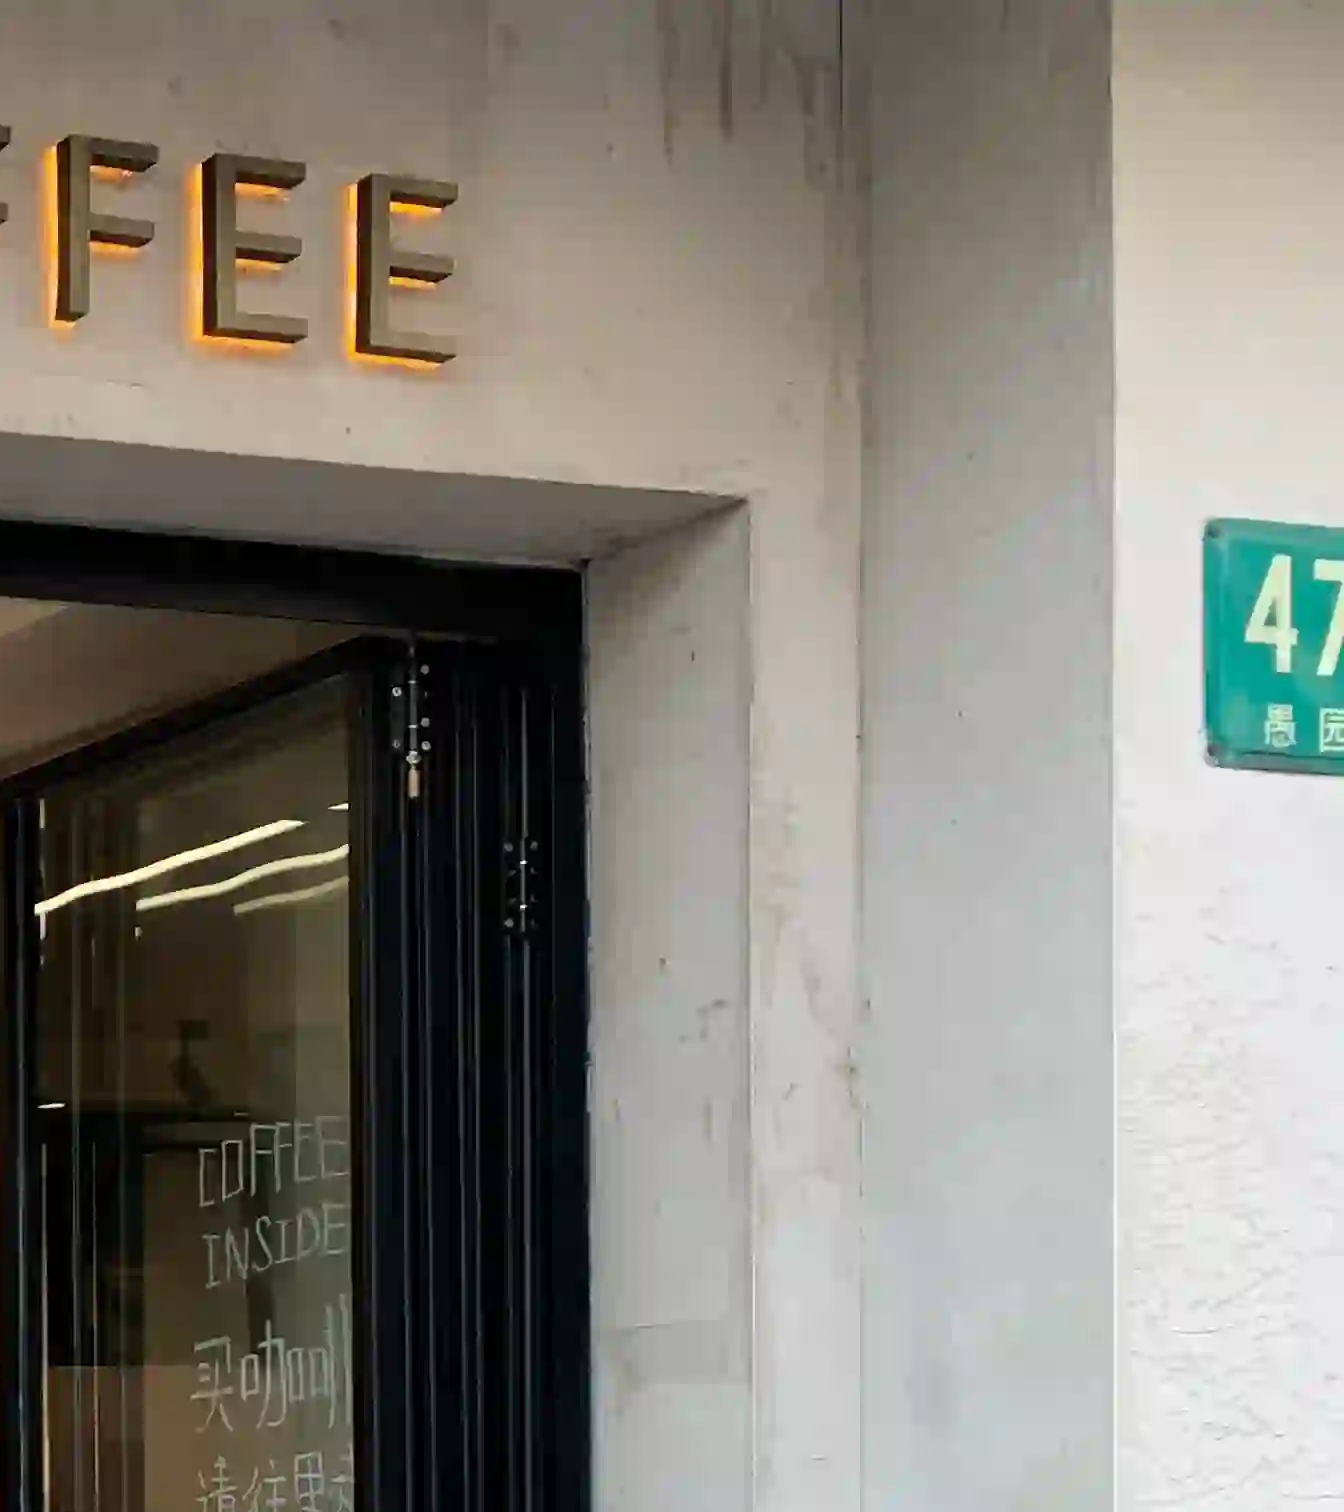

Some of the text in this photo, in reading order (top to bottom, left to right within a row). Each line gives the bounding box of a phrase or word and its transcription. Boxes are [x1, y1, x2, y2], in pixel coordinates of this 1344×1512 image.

[1244, 553, 1344, 675] 47
[198, 1114, 350, 1208] COFFEE
[201, 1202, 348, 1289] INSIDE
